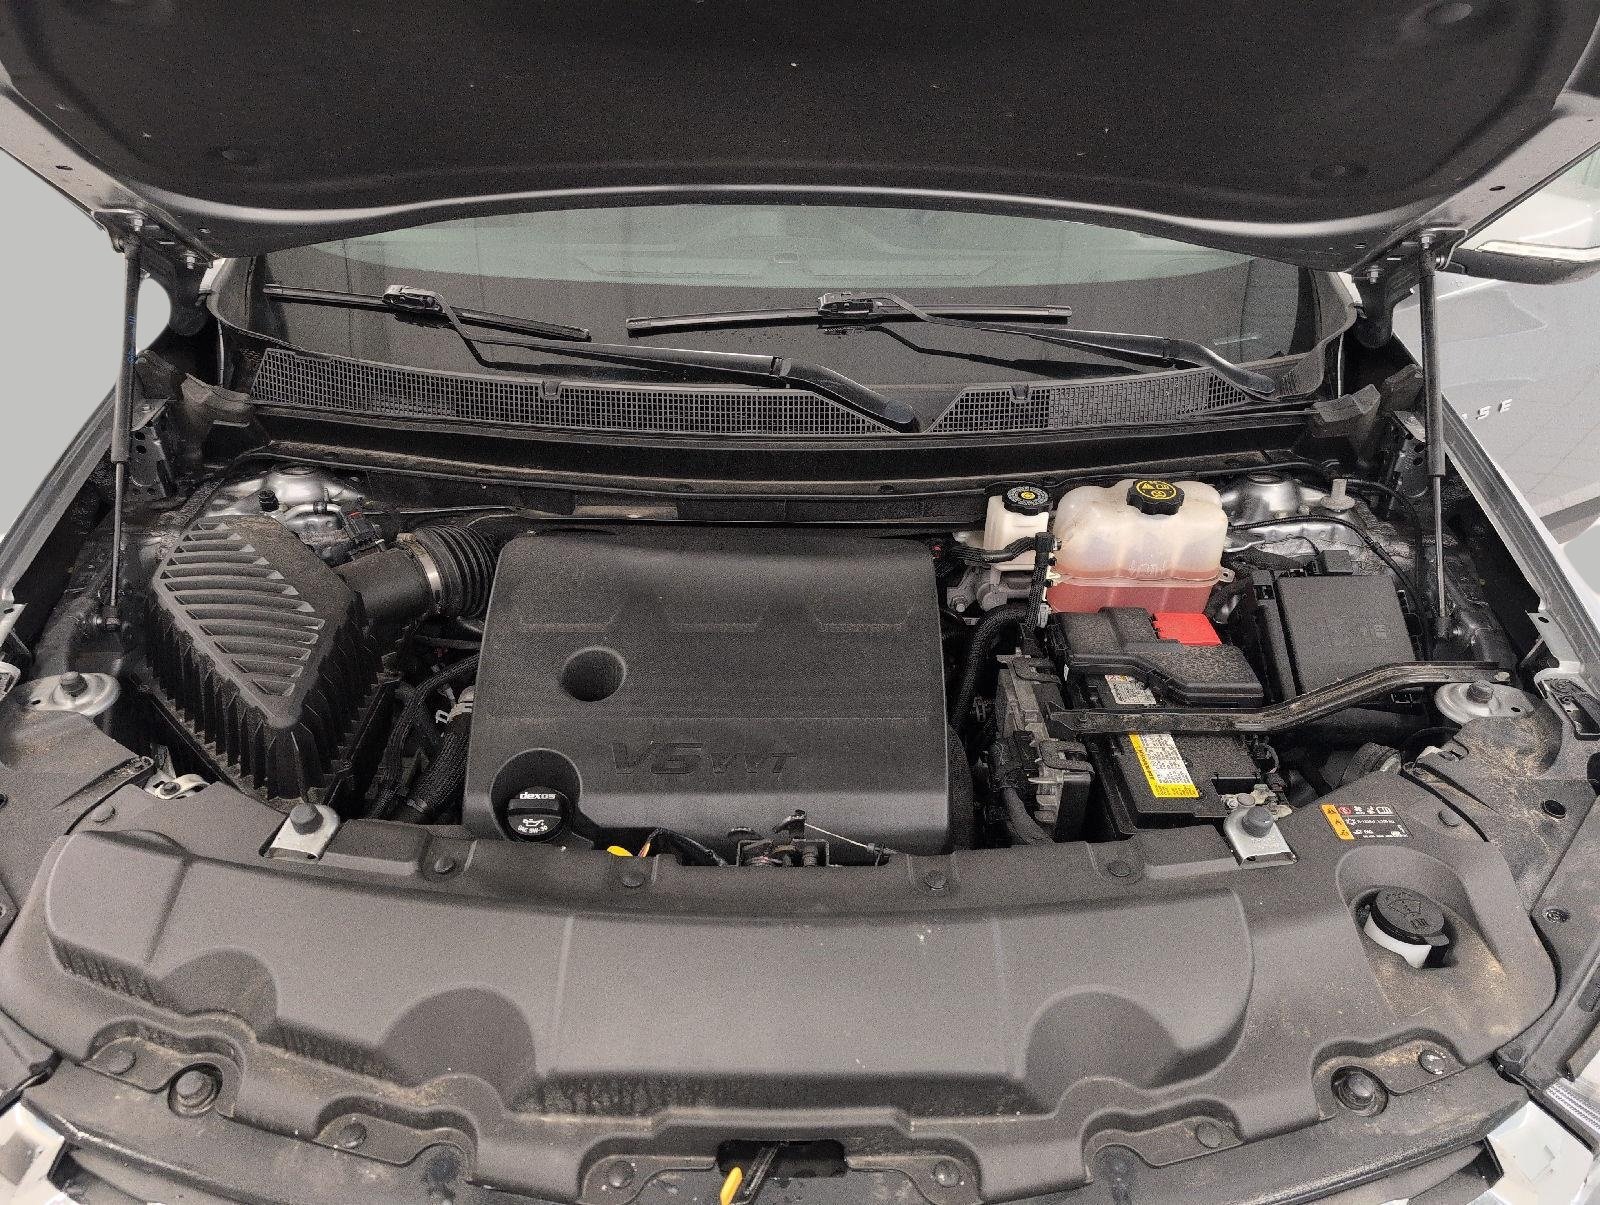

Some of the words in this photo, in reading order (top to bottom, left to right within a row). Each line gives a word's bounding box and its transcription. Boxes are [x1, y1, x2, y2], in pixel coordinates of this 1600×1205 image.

[612, 742, 703, 774] V6
[710, 752, 797, 774] VVT
[520, 791, 557, 800] dexos
